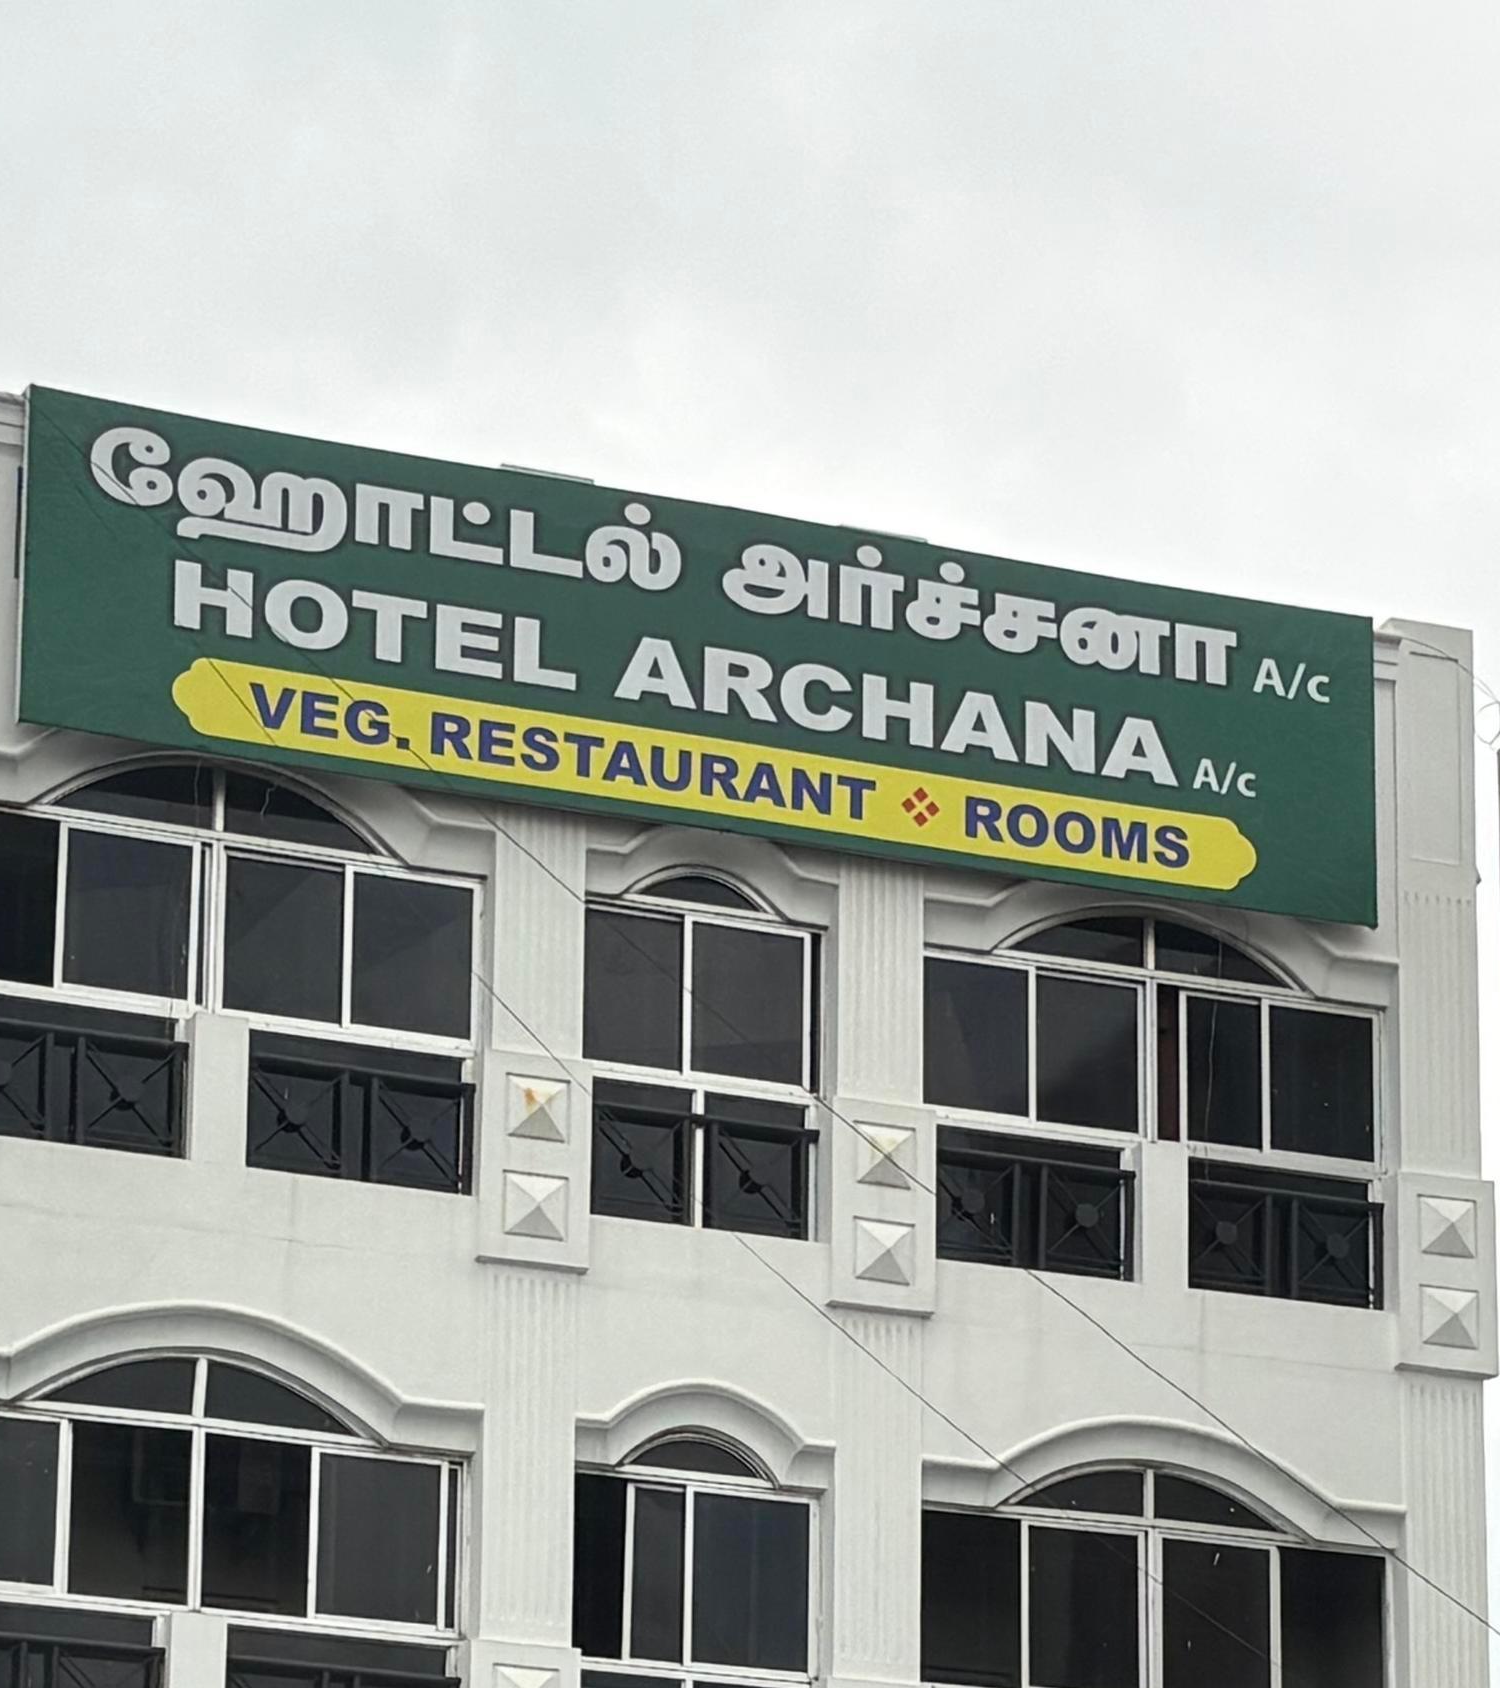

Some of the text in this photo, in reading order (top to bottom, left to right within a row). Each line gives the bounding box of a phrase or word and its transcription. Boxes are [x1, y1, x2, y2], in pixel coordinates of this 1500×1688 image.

[90, 427, 1238, 687] ஹோட்டல் அர்ச்சனா
[173, 560, 1180, 788] HOTEL ARCHANA
[1252, 657, 1331, 704] A/c
[248, 682, 1191, 870] VEG. RESTAURANT ROOMS
[1193, 757, 1257, 798] A/c
